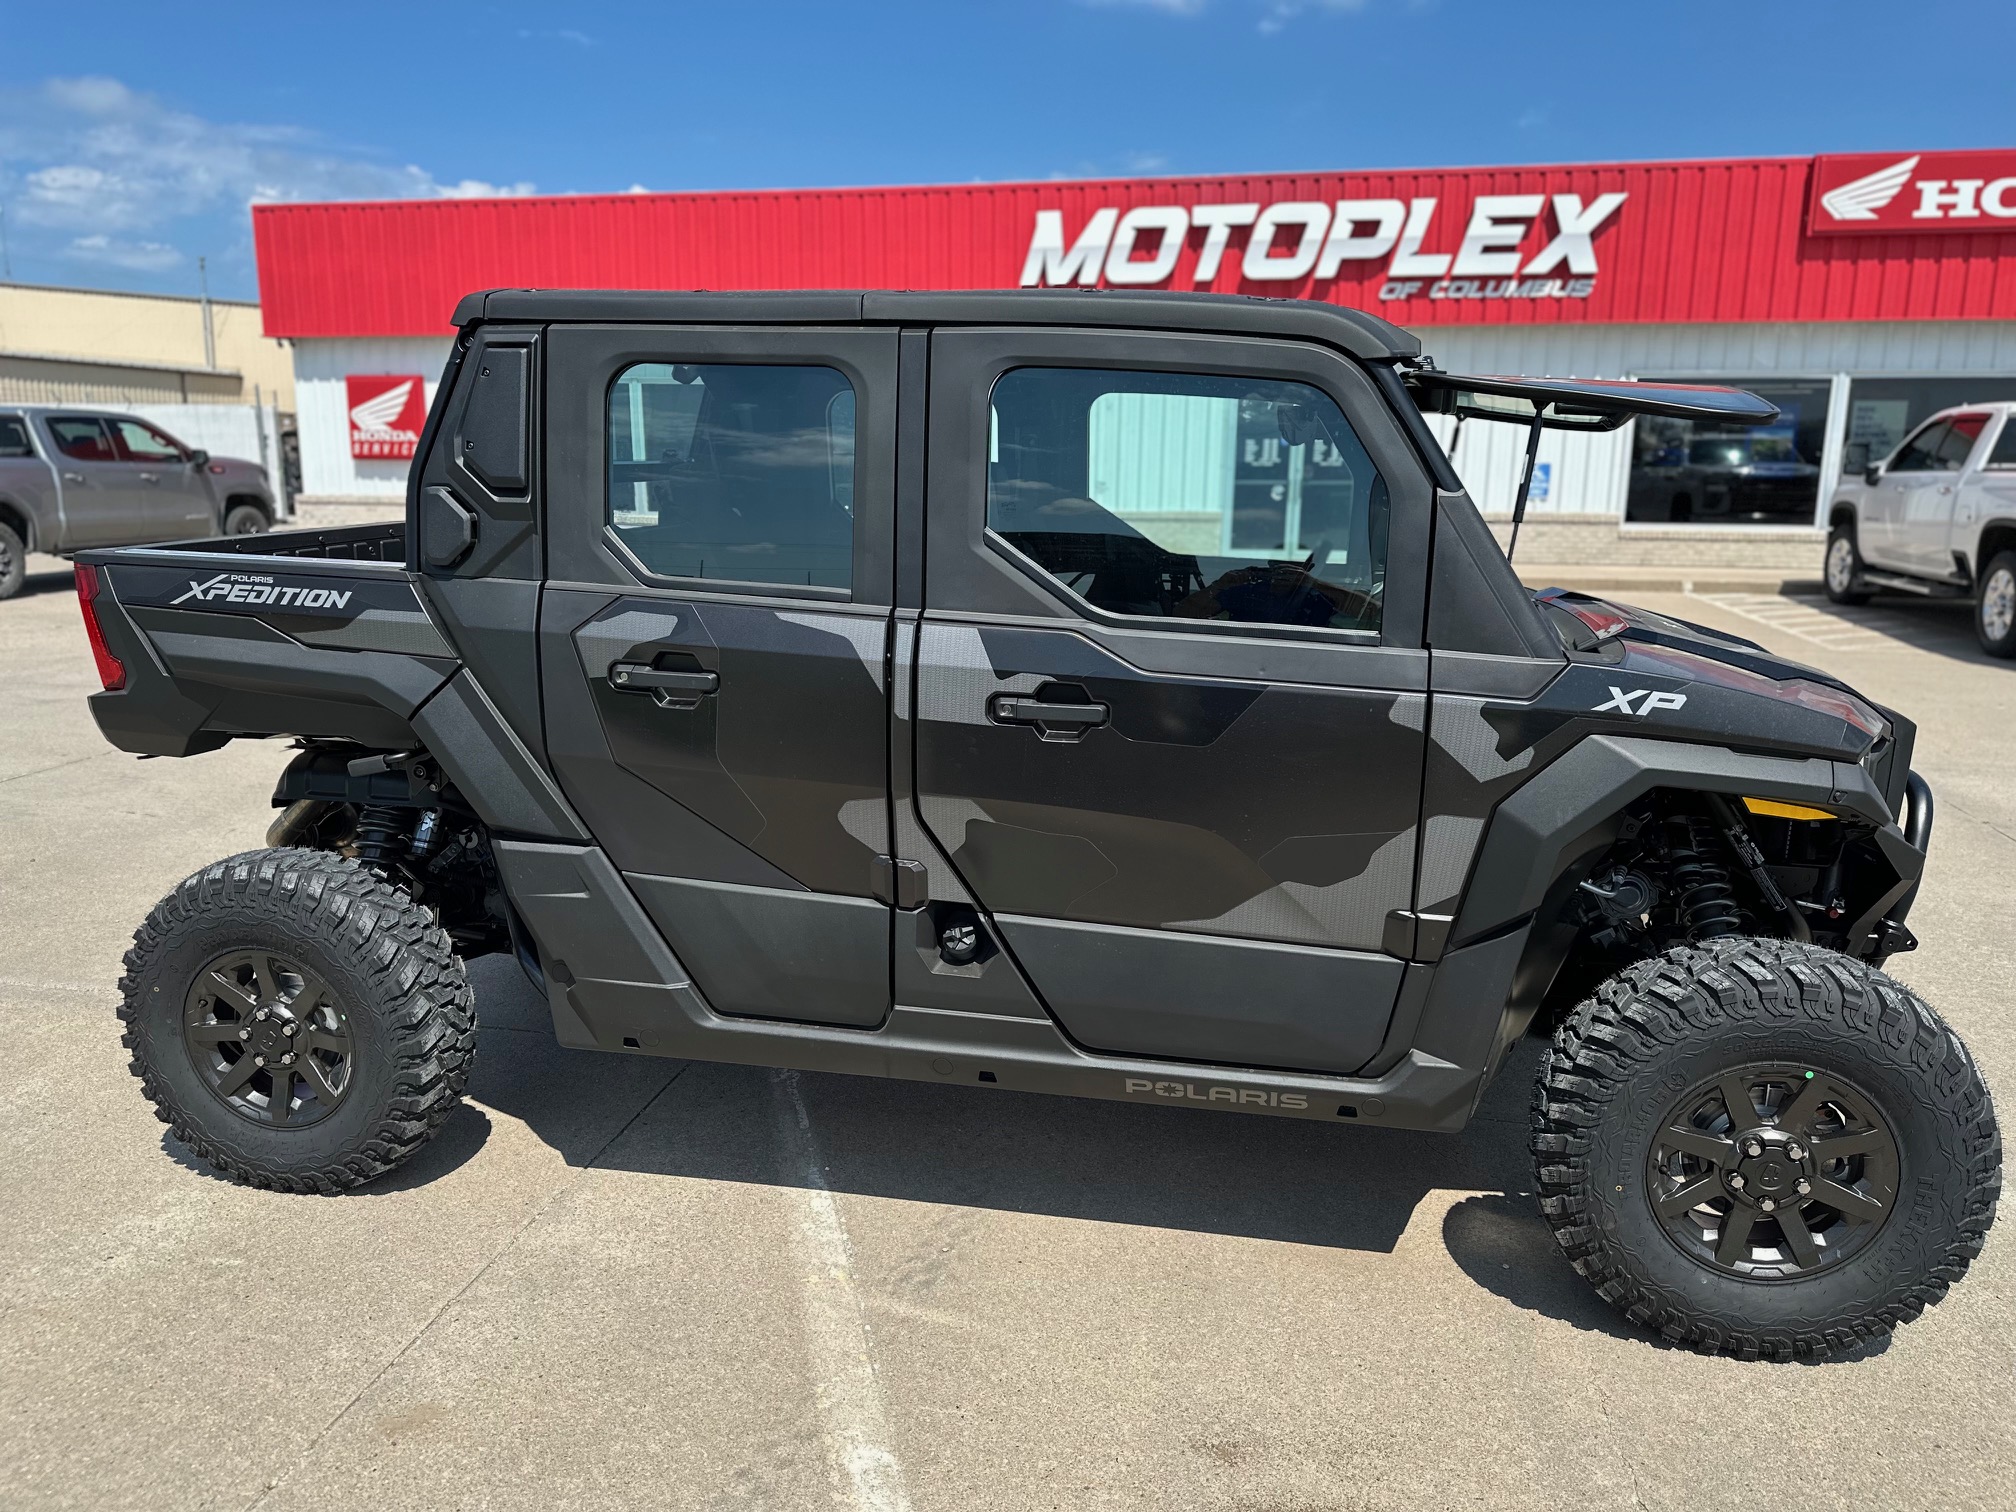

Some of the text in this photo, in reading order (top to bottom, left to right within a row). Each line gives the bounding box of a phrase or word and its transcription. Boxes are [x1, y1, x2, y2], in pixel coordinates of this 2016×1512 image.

[1019, 192, 1629, 286] MOTOPLEX
[1379, 279, 1596, 300] OF COLUMBUS
[352, 430, 419, 442] HONDA
[169, 574, 352, 609] XPEDITION
[231, 575, 274, 584] POLARIS
[1590, 686, 1688, 716] XP
[1125, 1078, 1309, 1110] POLARIS
